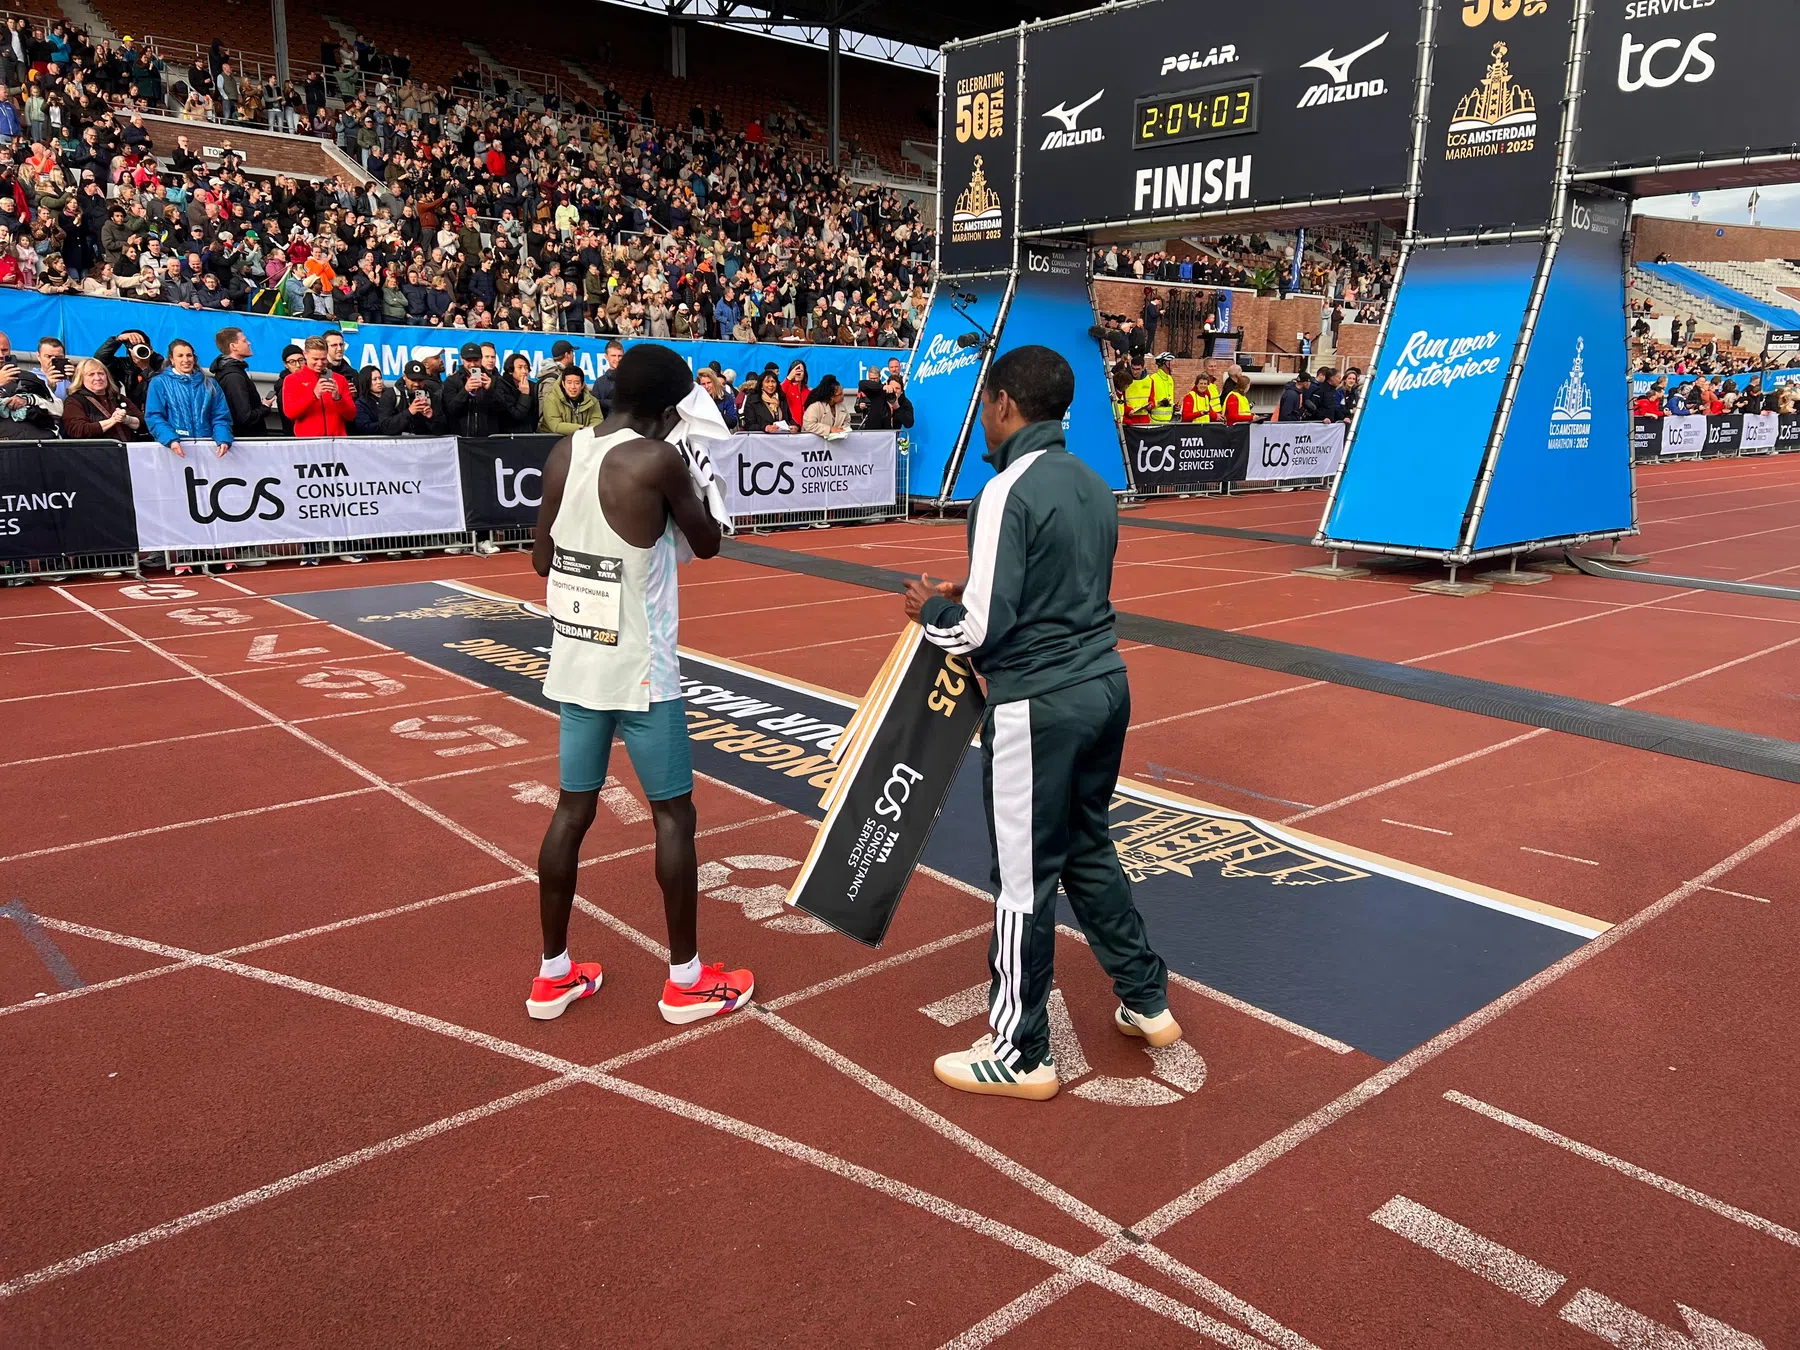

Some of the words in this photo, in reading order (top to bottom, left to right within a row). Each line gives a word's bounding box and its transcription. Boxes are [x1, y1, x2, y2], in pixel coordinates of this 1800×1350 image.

[1618, 32, 1717, 92] tcs
[957, 71, 1004, 95] CELEBRATING
[956, 92, 989, 143] 50
[989, 88, 1004, 138] YEARS
[1142, 92, 1250, 138] 2:04:03
[1447, 132, 1467, 147] tcs
[1467, 124, 1536, 145] AMSTERDAM
[1445, 144, 1498, 161] MARATHON
[1506, 139, 1534, 153] 2025
[1134, 155, 1252, 211] FINISH
[952, 221, 964, 232] tcs
[964, 218, 1002, 231] AMSTERDAM
[1571, 198, 1591, 230] tcs
[952, 231, 982, 243] MARATHON
[985, 230, 1001, 240] 2025
[1028, 249, 1050, 273] tcs
[1052, 252, 1065, 260] TATA
[923, 333, 954, 360] Run
[1396, 330, 1449, 367] Run
[1444, 331, 1501, 364] your
[913, 351, 980, 384] Masterpiece
[1379, 357, 1500, 400] Masterpiece
[1294, 435, 1312, 444] TATA
[1559, 423, 1591, 435] AMSTERDAM
[1669, 424, 1683, 446] tcs
[1178, 448, 1235, 459] CONSULTANCY
[1180, 437, 1204, 447] TATA
[1261, 436, 1291, 468] tcs
[1293, 445, 1332, 455] CONSULTANCY
[1547, 438, 1573, 449] MARATHON
[1576, 437, 1589, 449] 2025
[801, 450, 833, 463] TATA
[1137, 439, 1176, 473] tcs
[1178, 460, 1214, 471] SERVICES
[1291, 457, 1318, 466] SERVICES
[293, 462, 350, 479] TATA
[494, 457, 544, 508] tc
[738, 453, 795, 497] tcs
[801, 463, 875, 479] CONSULTANCY
[184, 466, 286, 525] tcs
[296, 480, 422, 500] CONSULTANCY
[801, 480, 849, 494] SERVICES
[299, 501, 379, 520] SERVICES
[597, 570, 617, 579] TATA
[575, 586, 610, 598] KIPCHUMBA
[573, 600, 580, 614] 8
[245, 634, 331, 662] 7
[593, 630, 617, 643] 2025
[927, 652, 971, 718] 025
[389, 715, 529, 758] 5
[757, 713, 846, 750] OUR
[875, 763, 924, 822] tcs
[847, 817, 876, 868] SERVICES
[876, 831, 900, 864] TATA
[846, 824, 887, 902] CONSULTANCY
